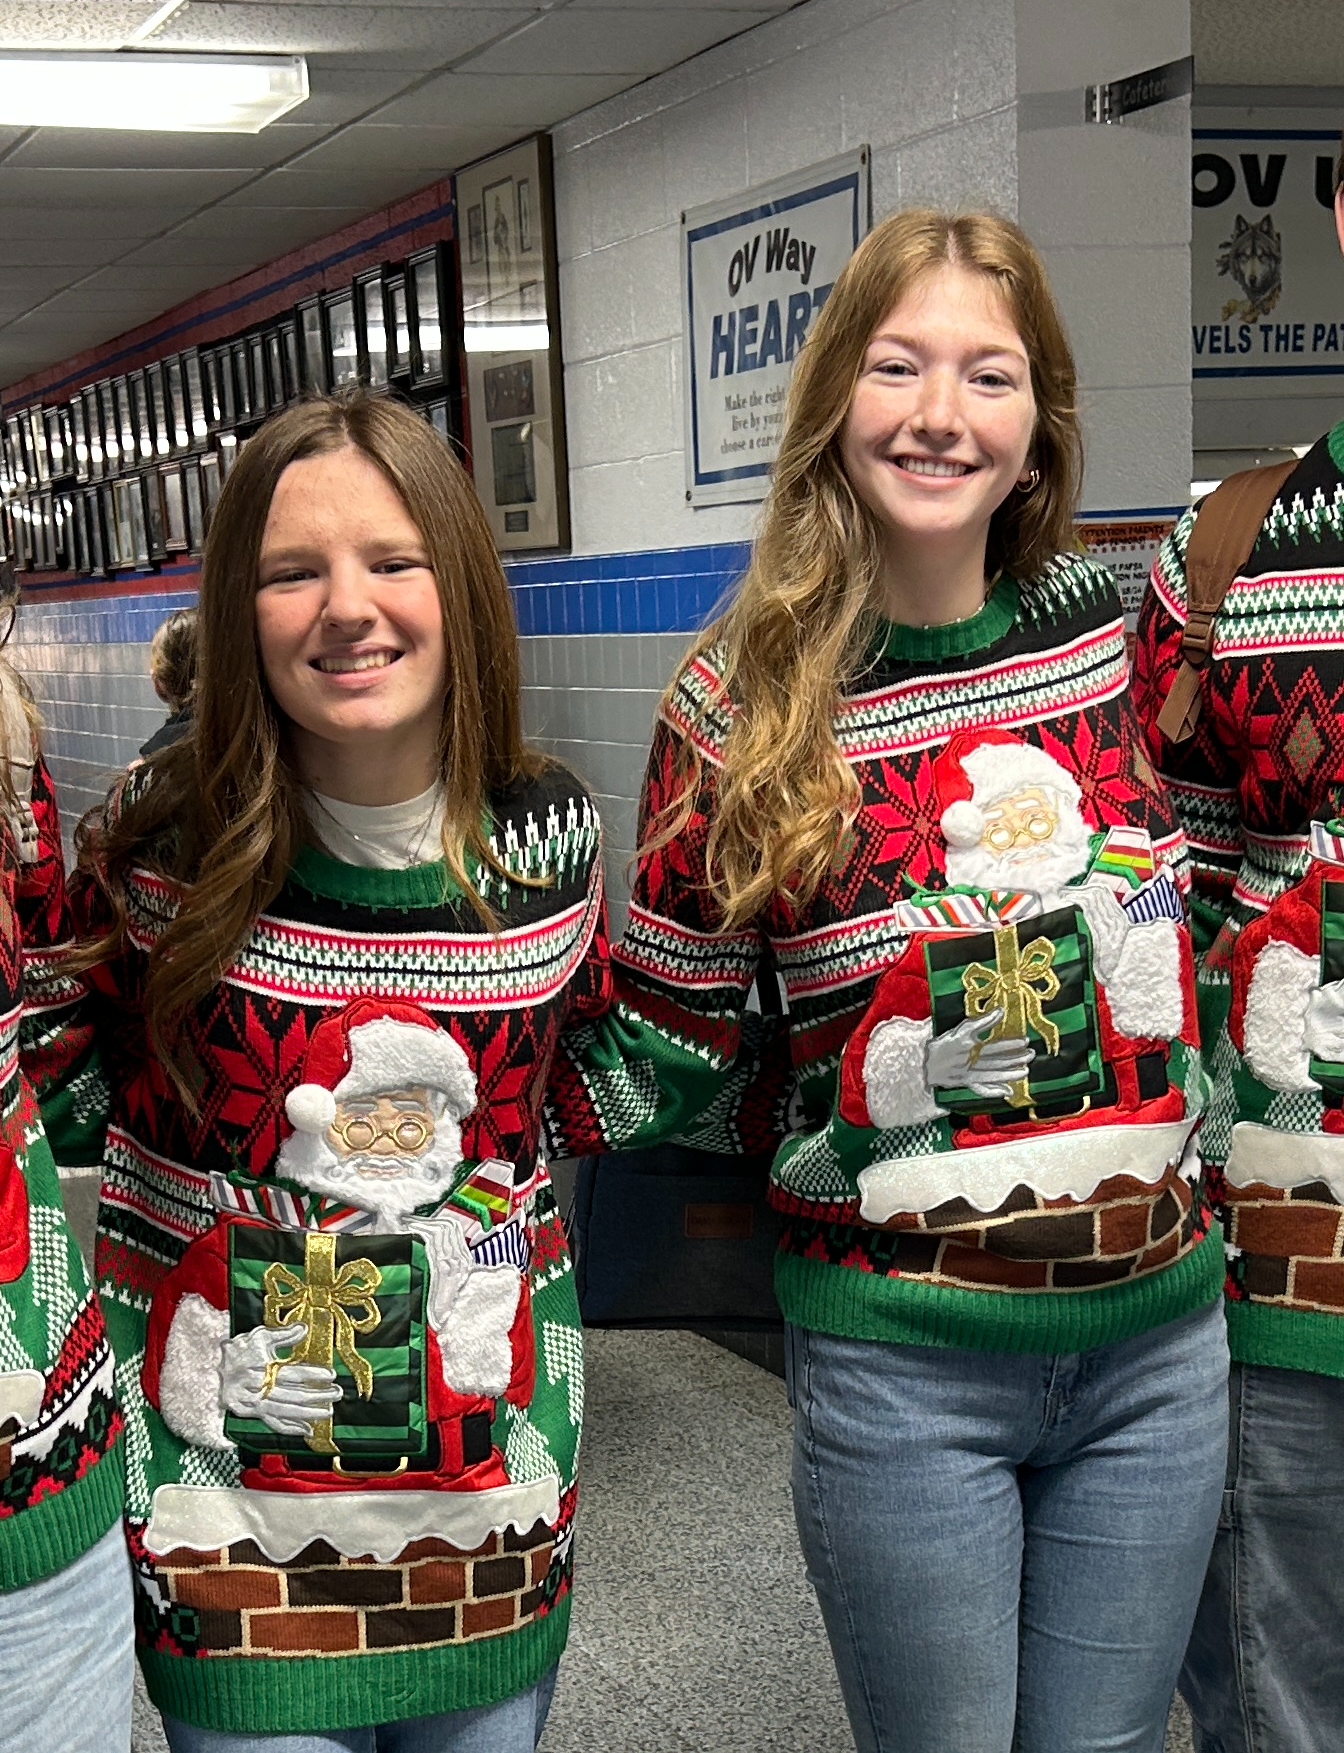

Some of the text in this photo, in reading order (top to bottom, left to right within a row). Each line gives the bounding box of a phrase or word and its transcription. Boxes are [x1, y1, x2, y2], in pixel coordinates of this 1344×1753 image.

[1192, 153, 1287, 209] OV
[728, 227, 816, 297] OV Way
[1259, 324, 1305, 353] THE
[725, 393, 747, 411] Make
[750, 389, 762, 407] the
